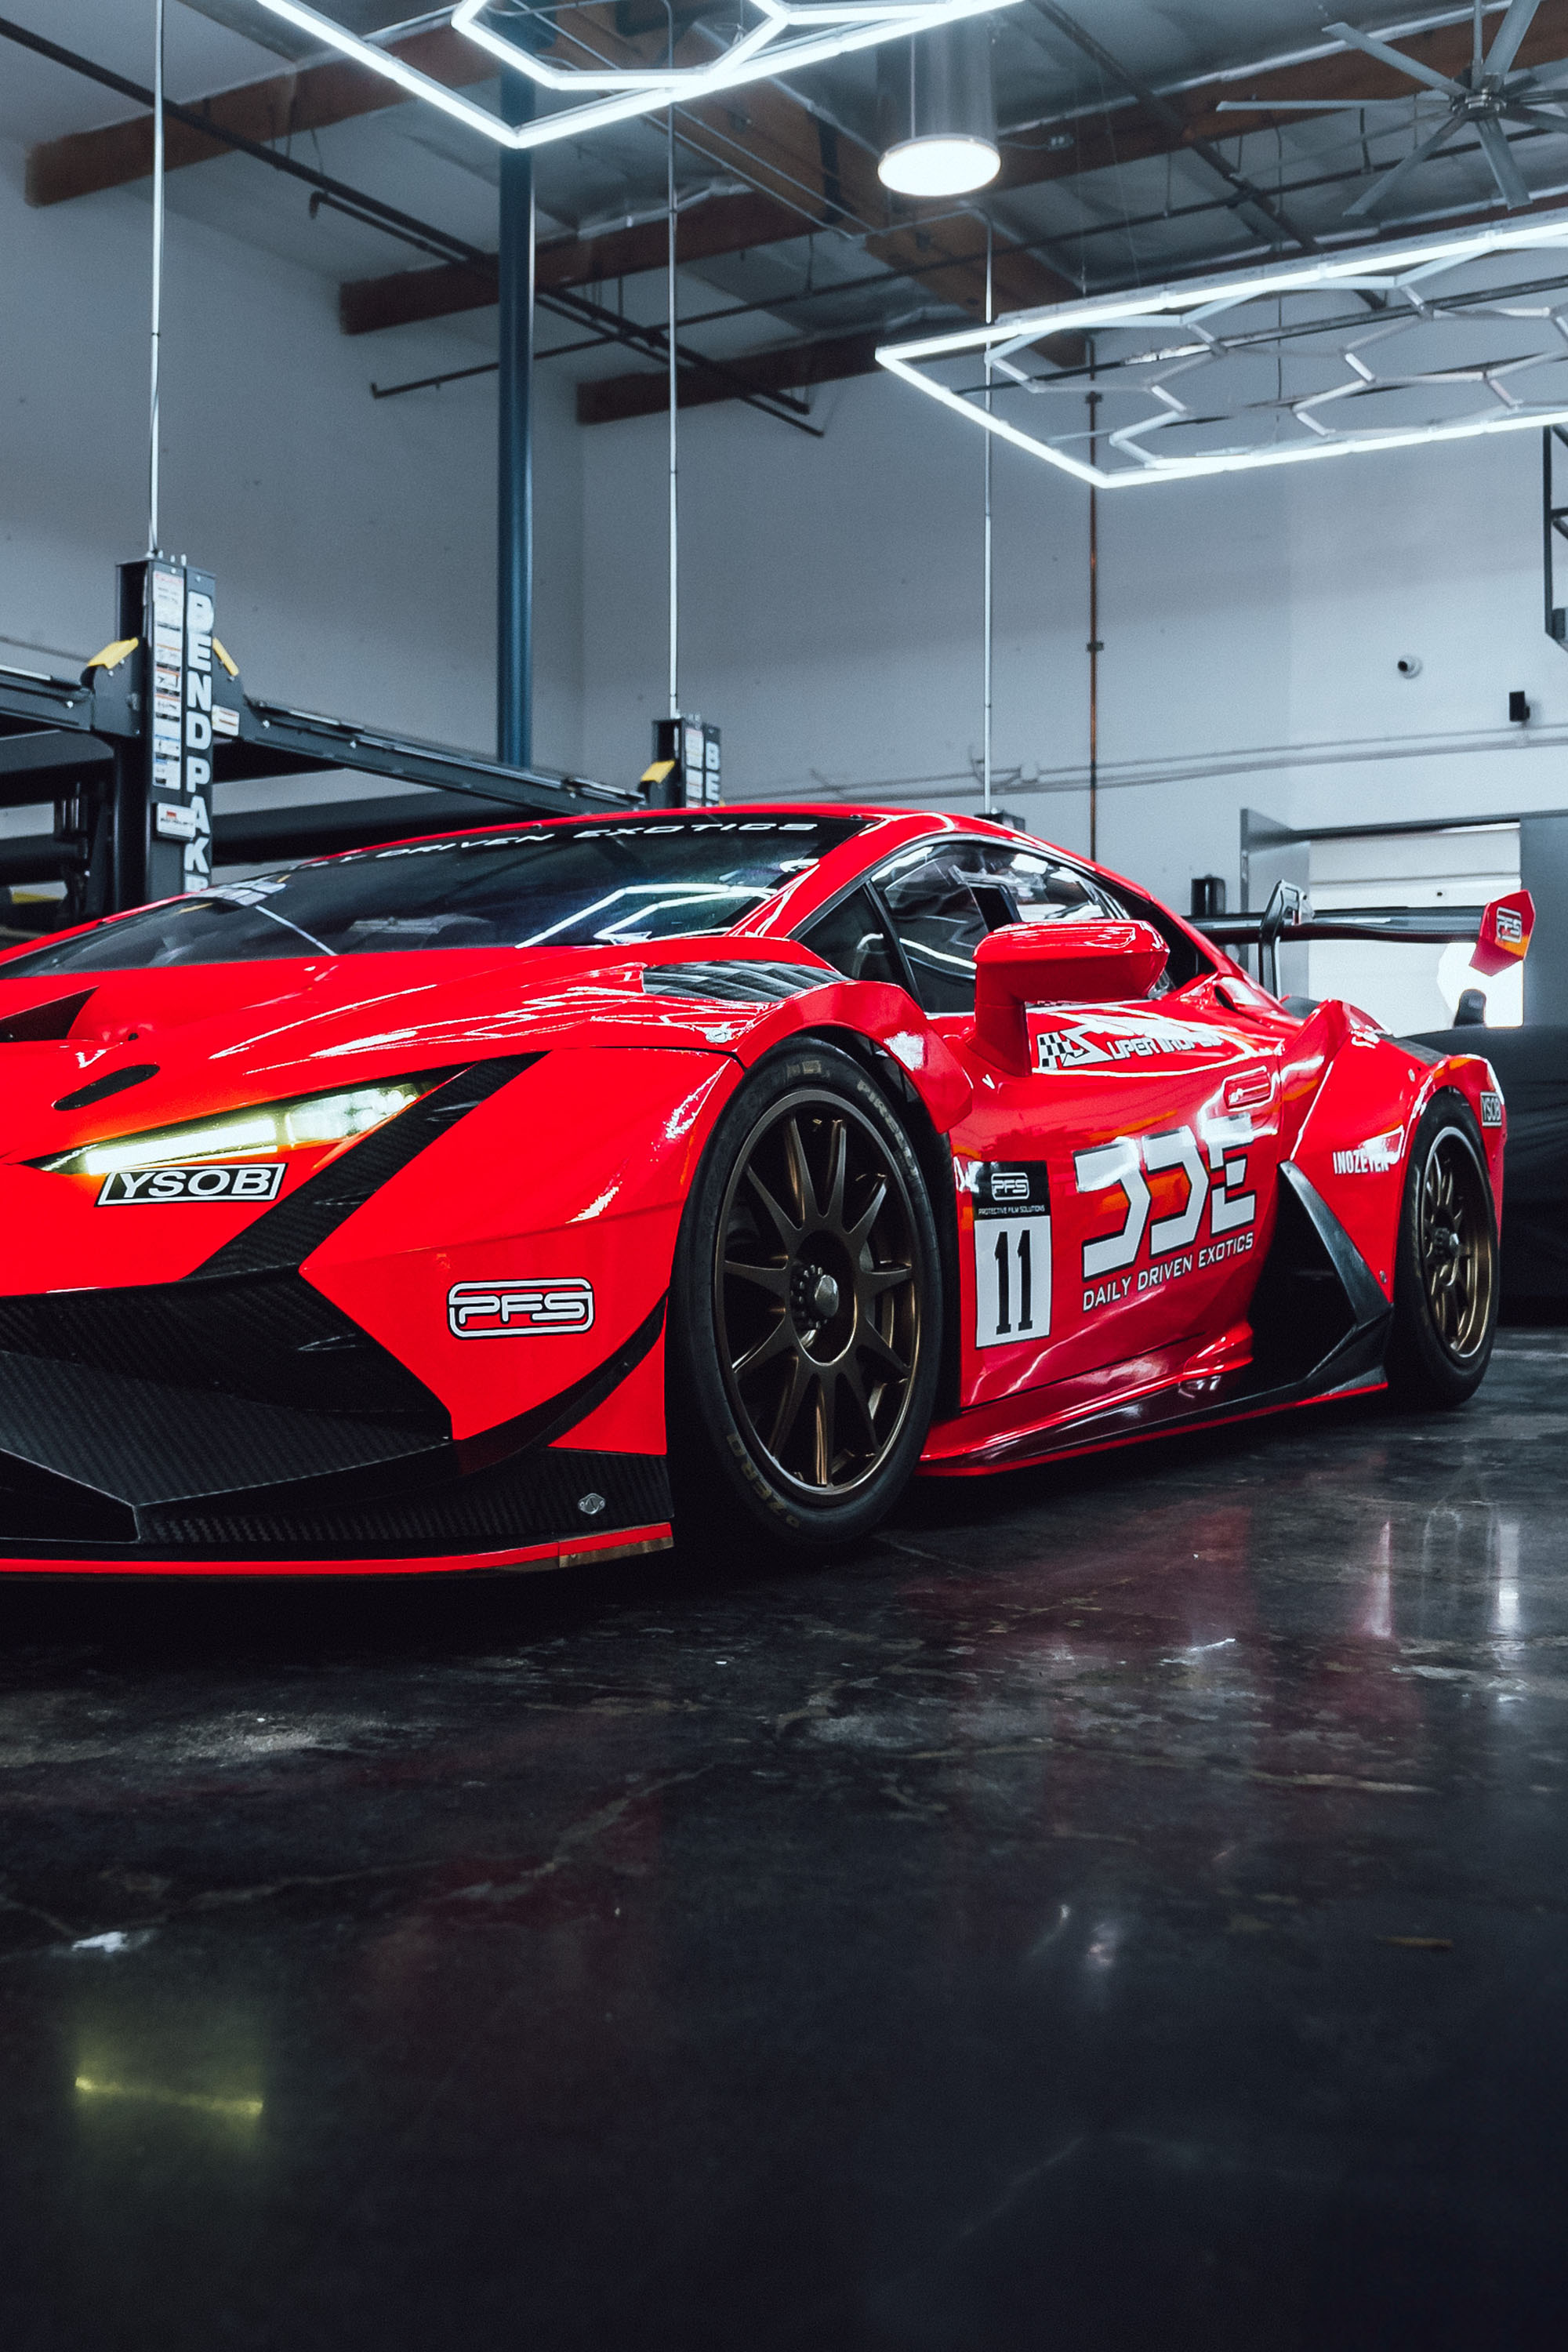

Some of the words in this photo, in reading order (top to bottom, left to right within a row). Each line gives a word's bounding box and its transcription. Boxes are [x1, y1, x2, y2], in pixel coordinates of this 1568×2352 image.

[573, 822, 818, 839] EXOTICS
[1482, 1096, 1501, 1121] YSOB
[118, 1168, 270, 1199] YSOB
[991, 1177, 1029, 1196] PFS
[994, 1229, 1033, 1335] 11
[1083, 1276, 1132, 1312] DAILY
[1138, 1254, 1193, 1291] DRIVEN
[1198, 1232, 1254, 1268] EXOTICS
[448, 1289, 593, 1327] PFS
